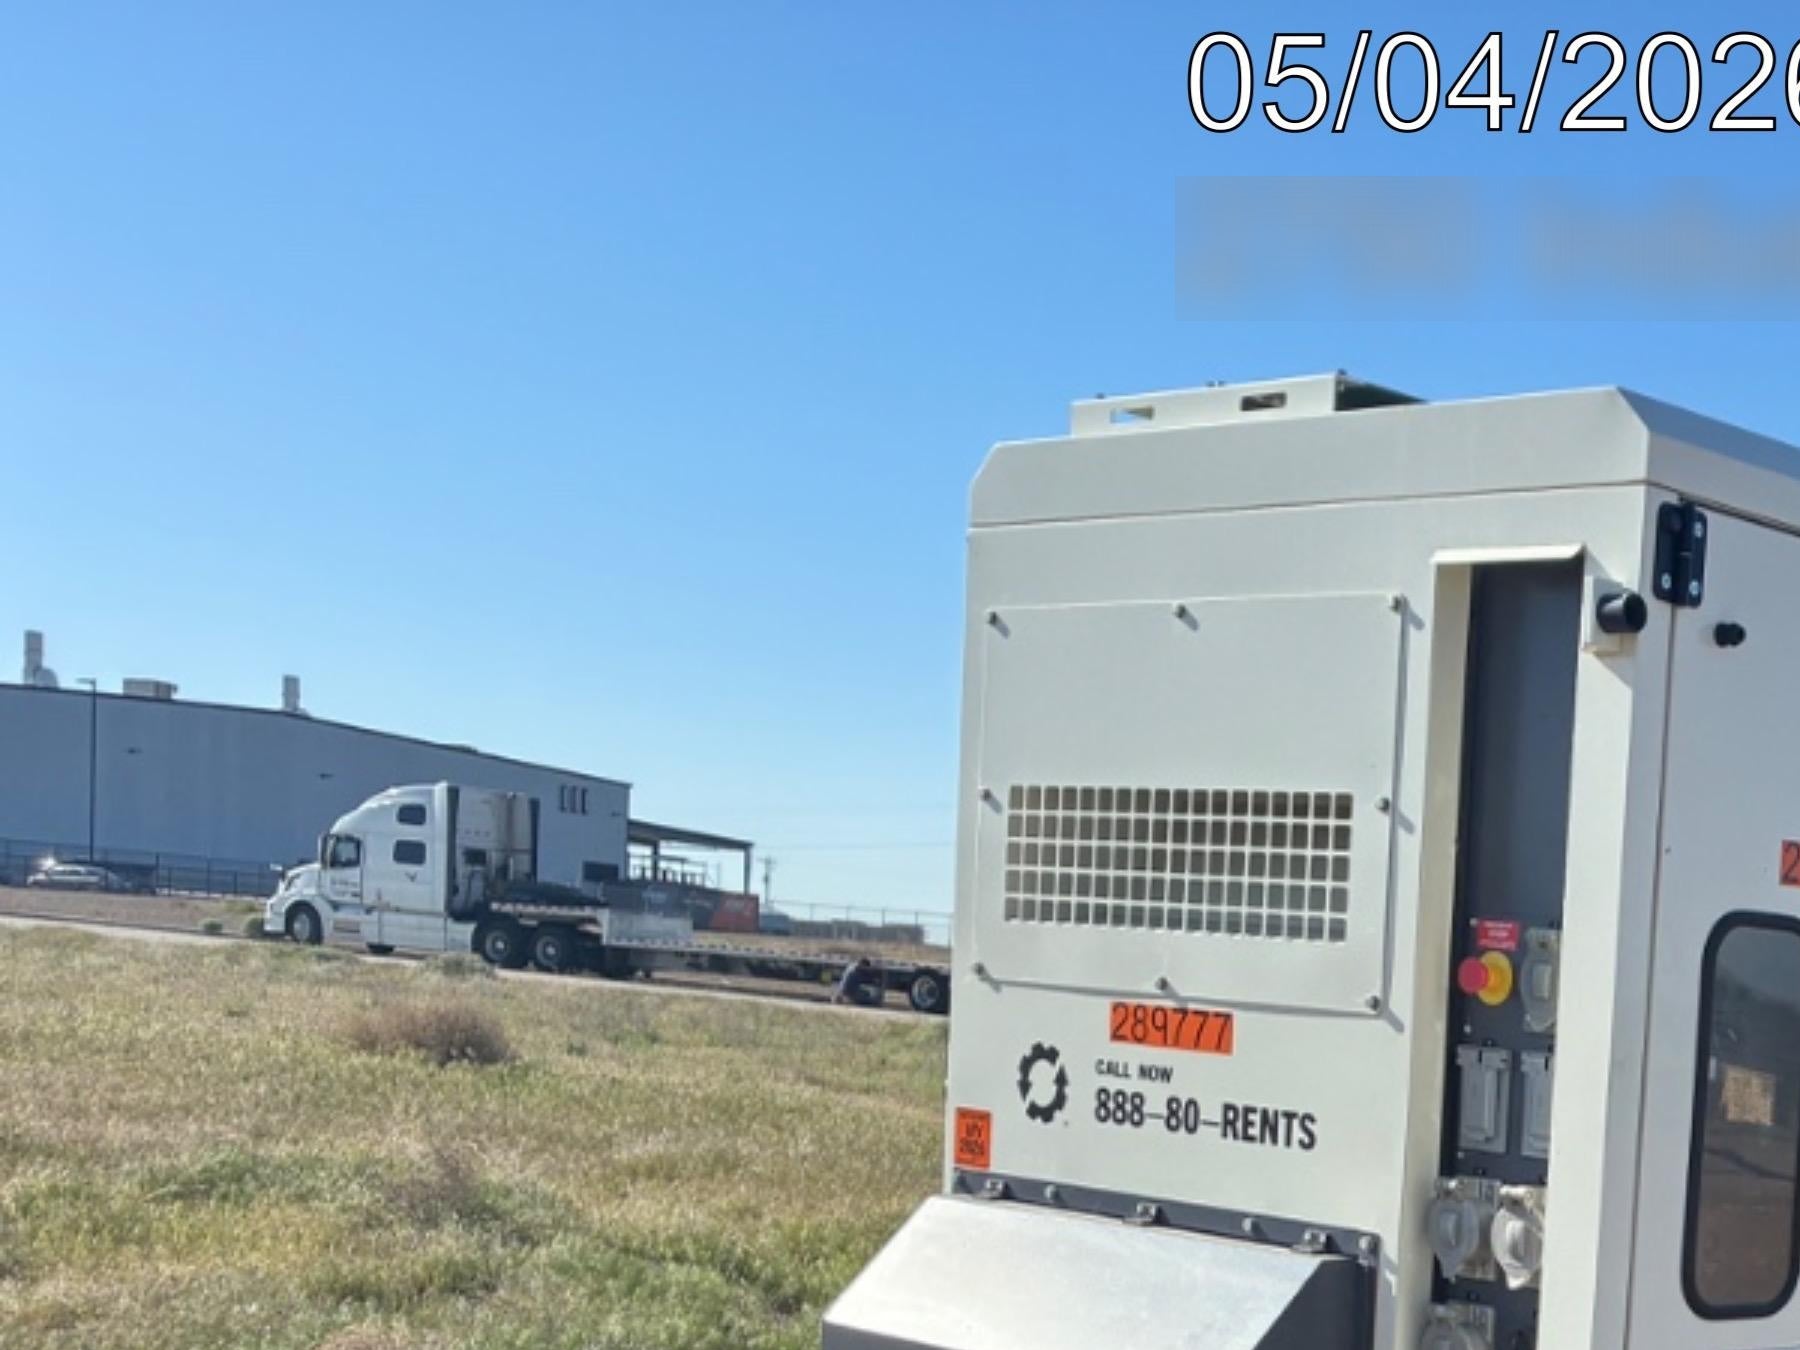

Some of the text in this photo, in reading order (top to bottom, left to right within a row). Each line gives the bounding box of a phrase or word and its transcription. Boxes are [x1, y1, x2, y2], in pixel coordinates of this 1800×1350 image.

[1110, 1002, 1233, 1052] 289777
[1095, 1058, 1174, 1083] CALL NOW
[1095, 1086, 1317, 1150] 888-80-RENTS
